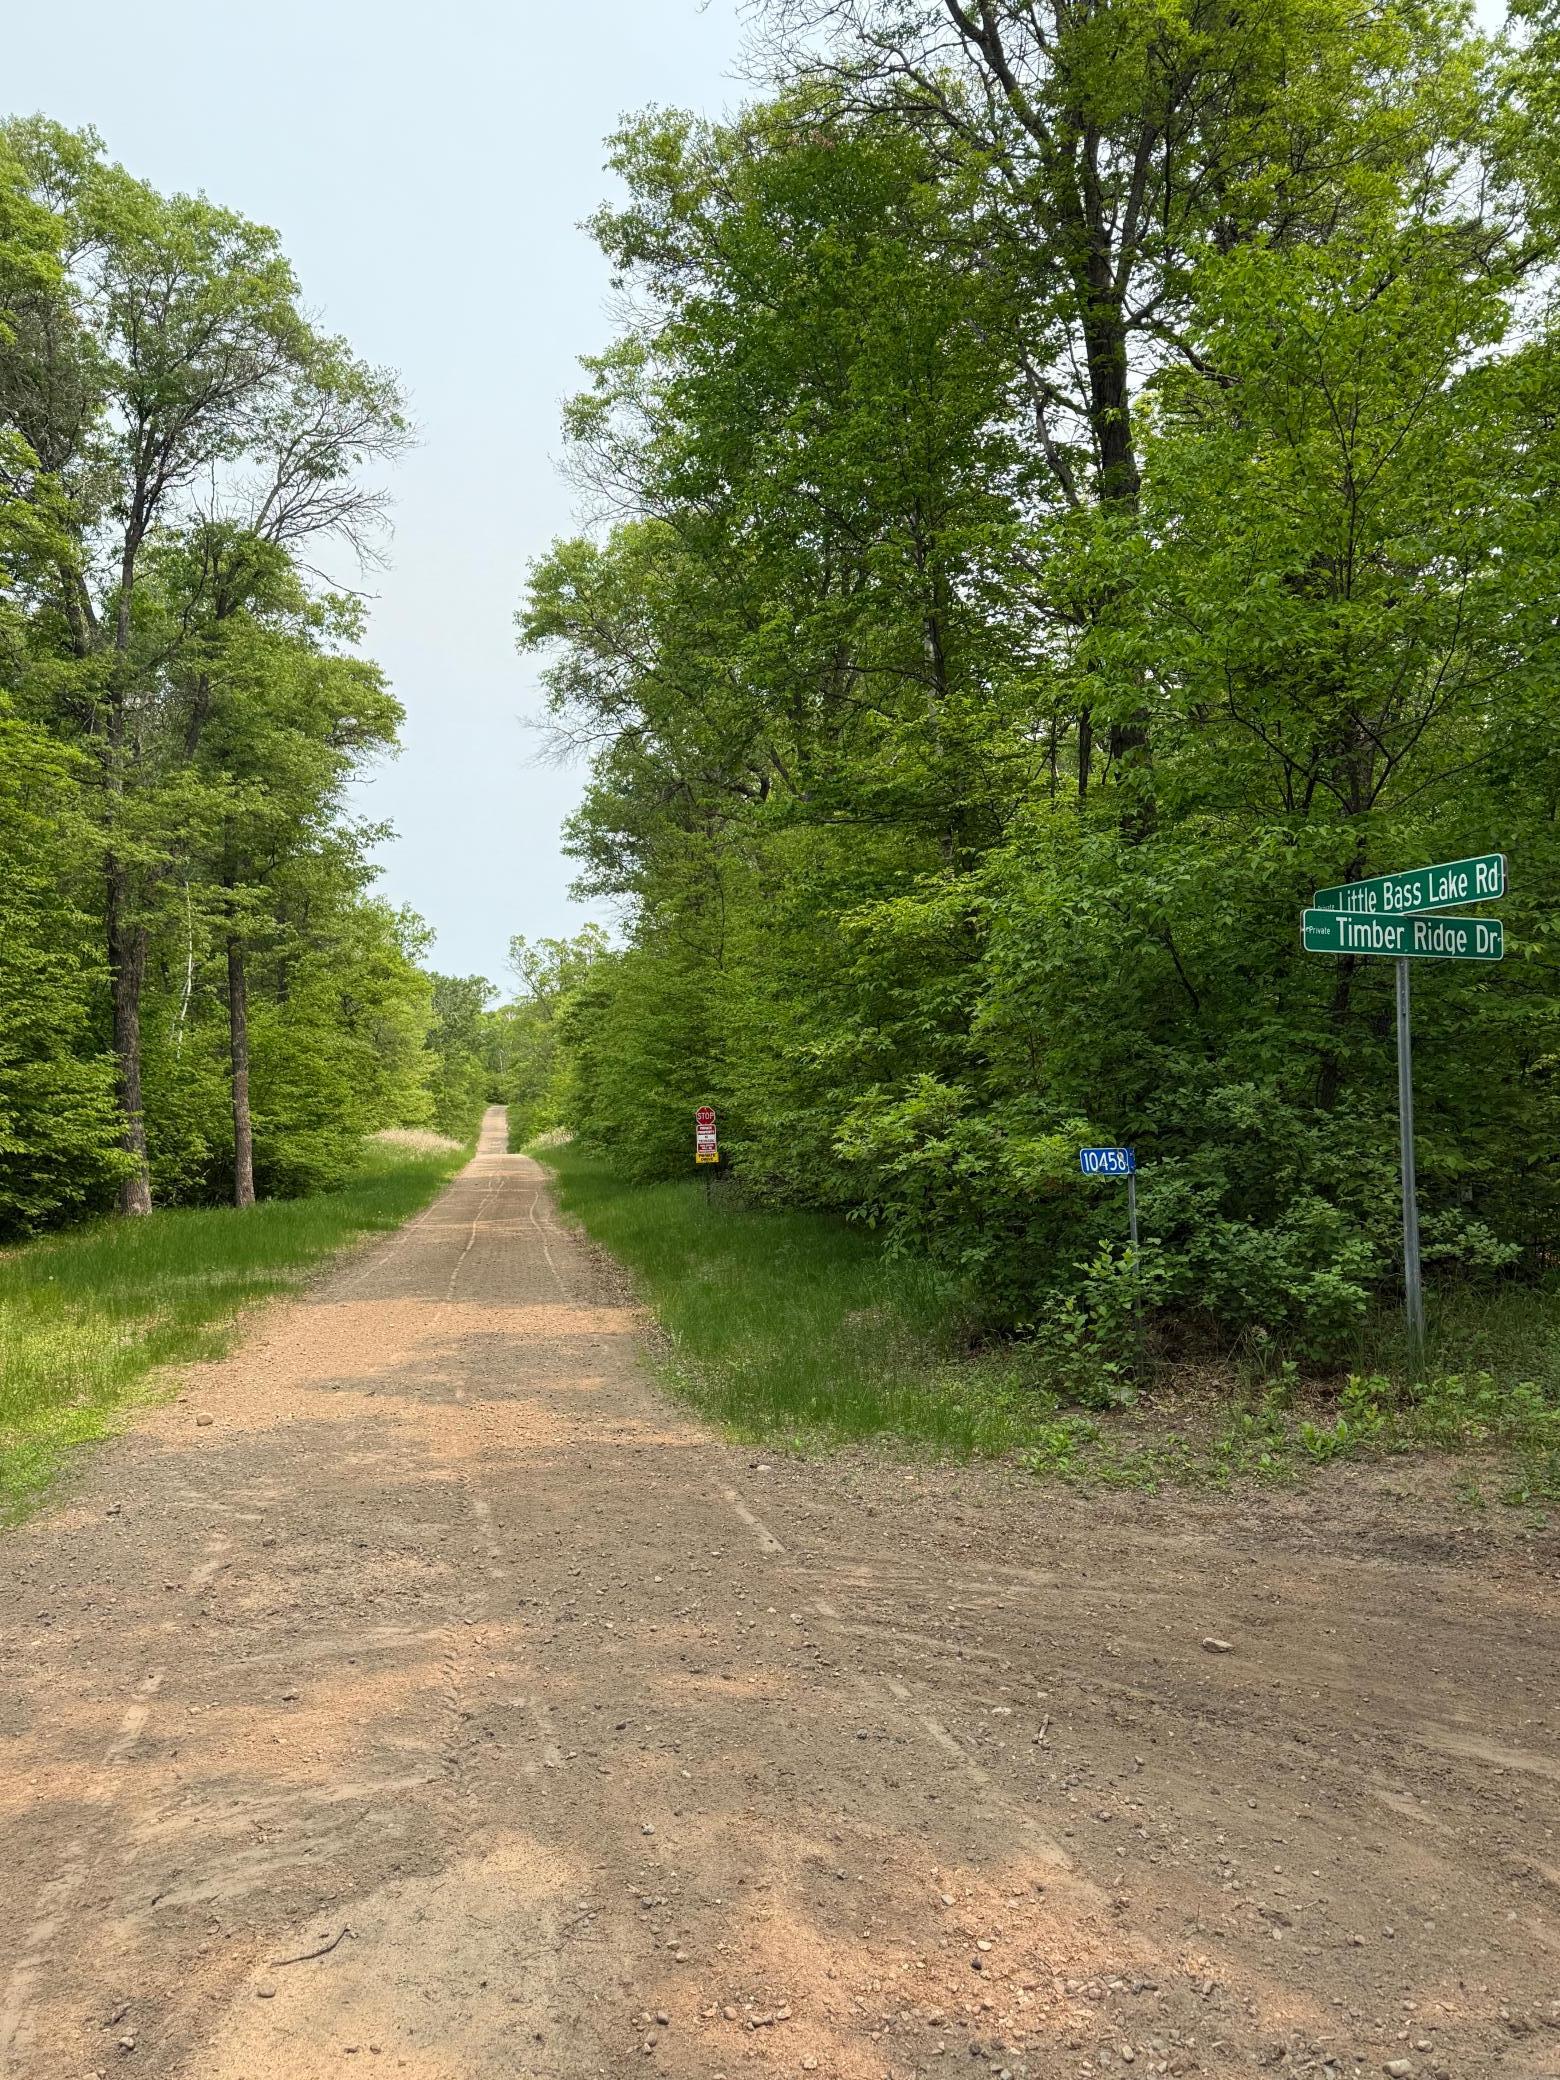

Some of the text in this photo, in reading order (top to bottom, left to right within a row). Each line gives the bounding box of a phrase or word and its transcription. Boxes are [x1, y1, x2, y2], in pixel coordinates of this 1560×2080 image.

[1339, 887, 1377, 912] Little
[1383, 881, 1421, 911] Bass
[1429, 870, 1468, 902] Lake
[1476, 861, 1498, 894] Rd
[1309, 916, 1498, 956] Private Timber Ridge Dr
[697, 1112, 715, 1120] STOP
[1084, 1152, 1126, 1171] 10458
